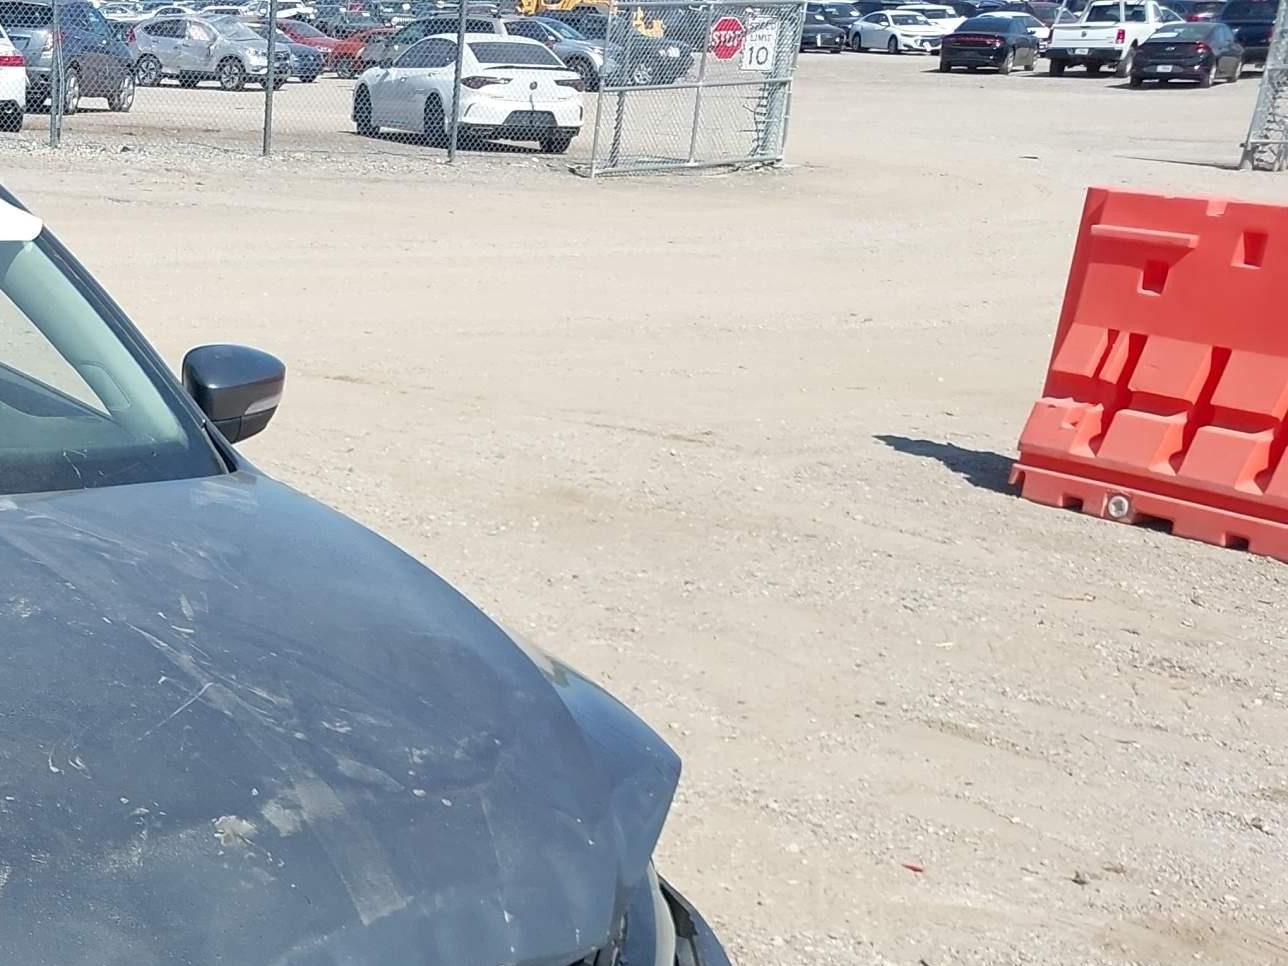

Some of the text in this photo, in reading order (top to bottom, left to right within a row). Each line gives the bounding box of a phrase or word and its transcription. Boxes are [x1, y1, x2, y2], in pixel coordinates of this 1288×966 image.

[712, 30, 743, 47] STOP
[750, 34, 773, 42] LIMIT
[748, 46, 769, 65] 10
